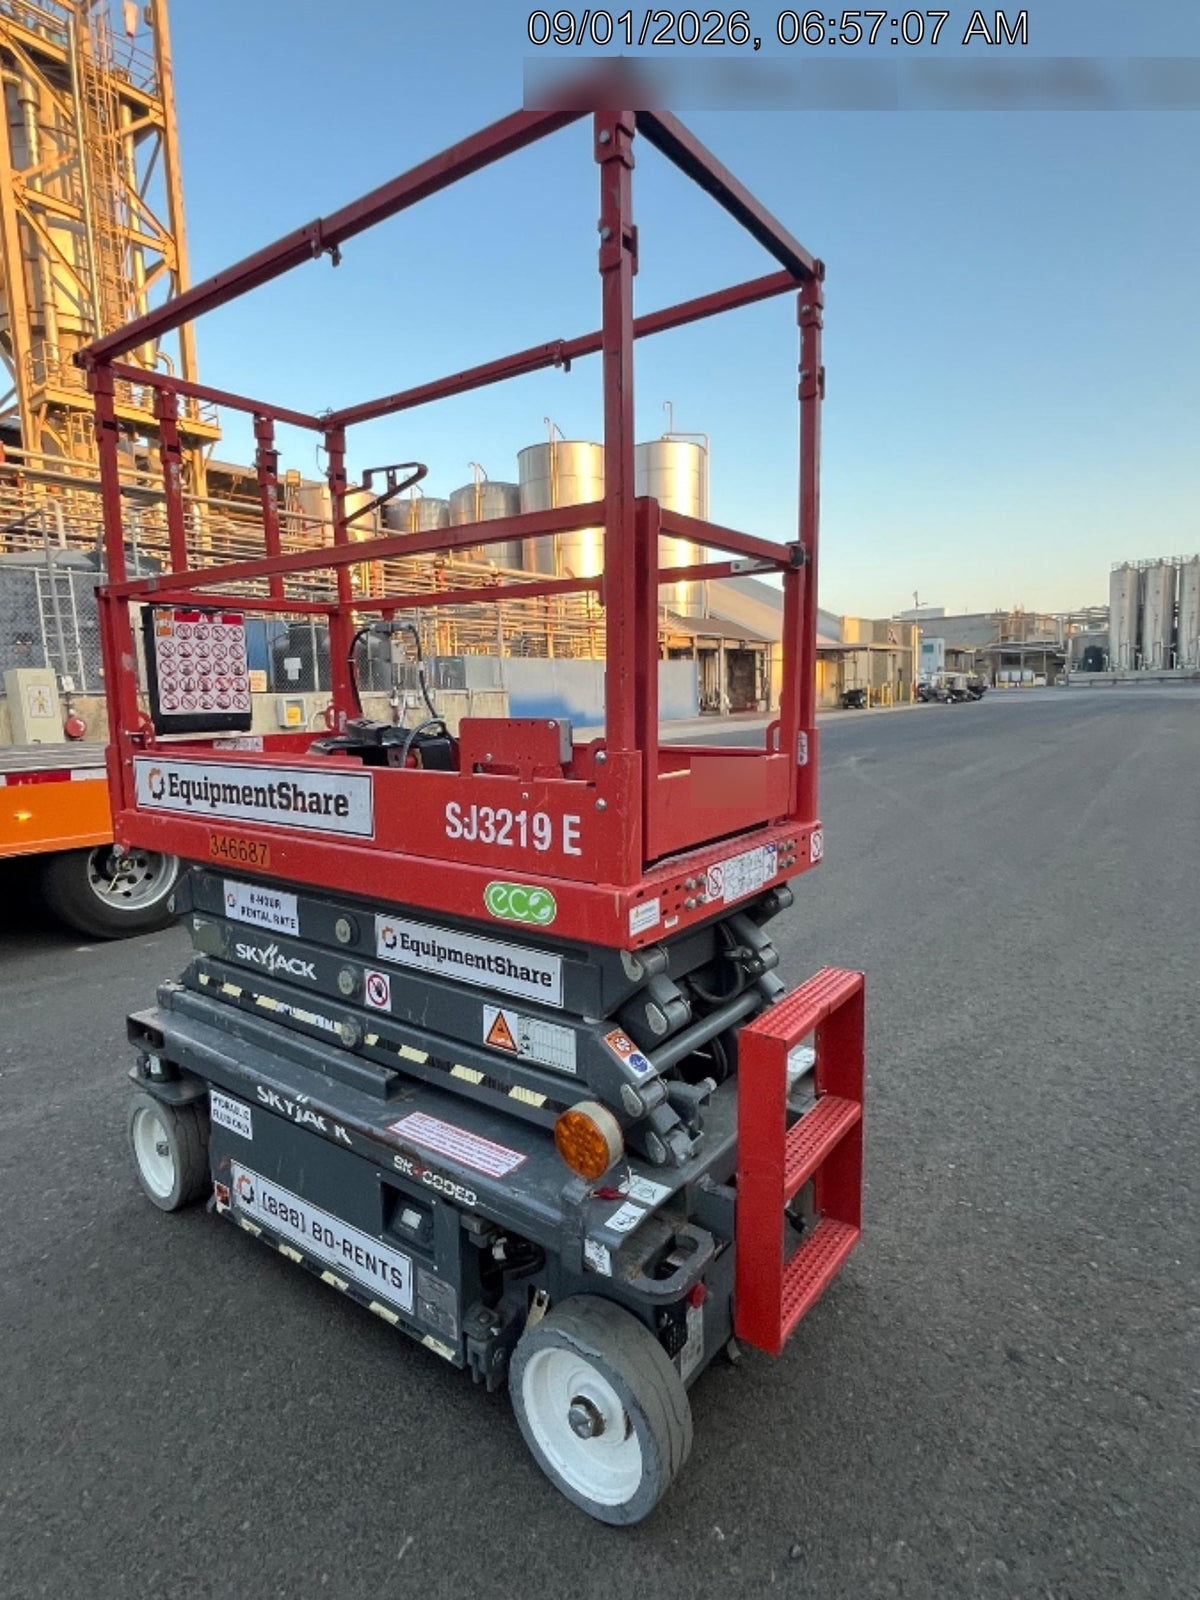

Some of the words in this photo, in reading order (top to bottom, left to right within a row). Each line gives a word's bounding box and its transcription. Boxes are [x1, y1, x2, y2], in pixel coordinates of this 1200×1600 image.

[168, 773, 349, 817] EquipmentShare
[210, 834, 268, 865] 346687
[445, 801, 552, 851] SJ3219
[562, 814, 582, 856] E
[488, 885, 552, 920] eco
[235, 942, 317, 981] SKYJACK
[399, 932, 552, 988] EquipmentShare
[262, 1191, 307, 1233] (888)
